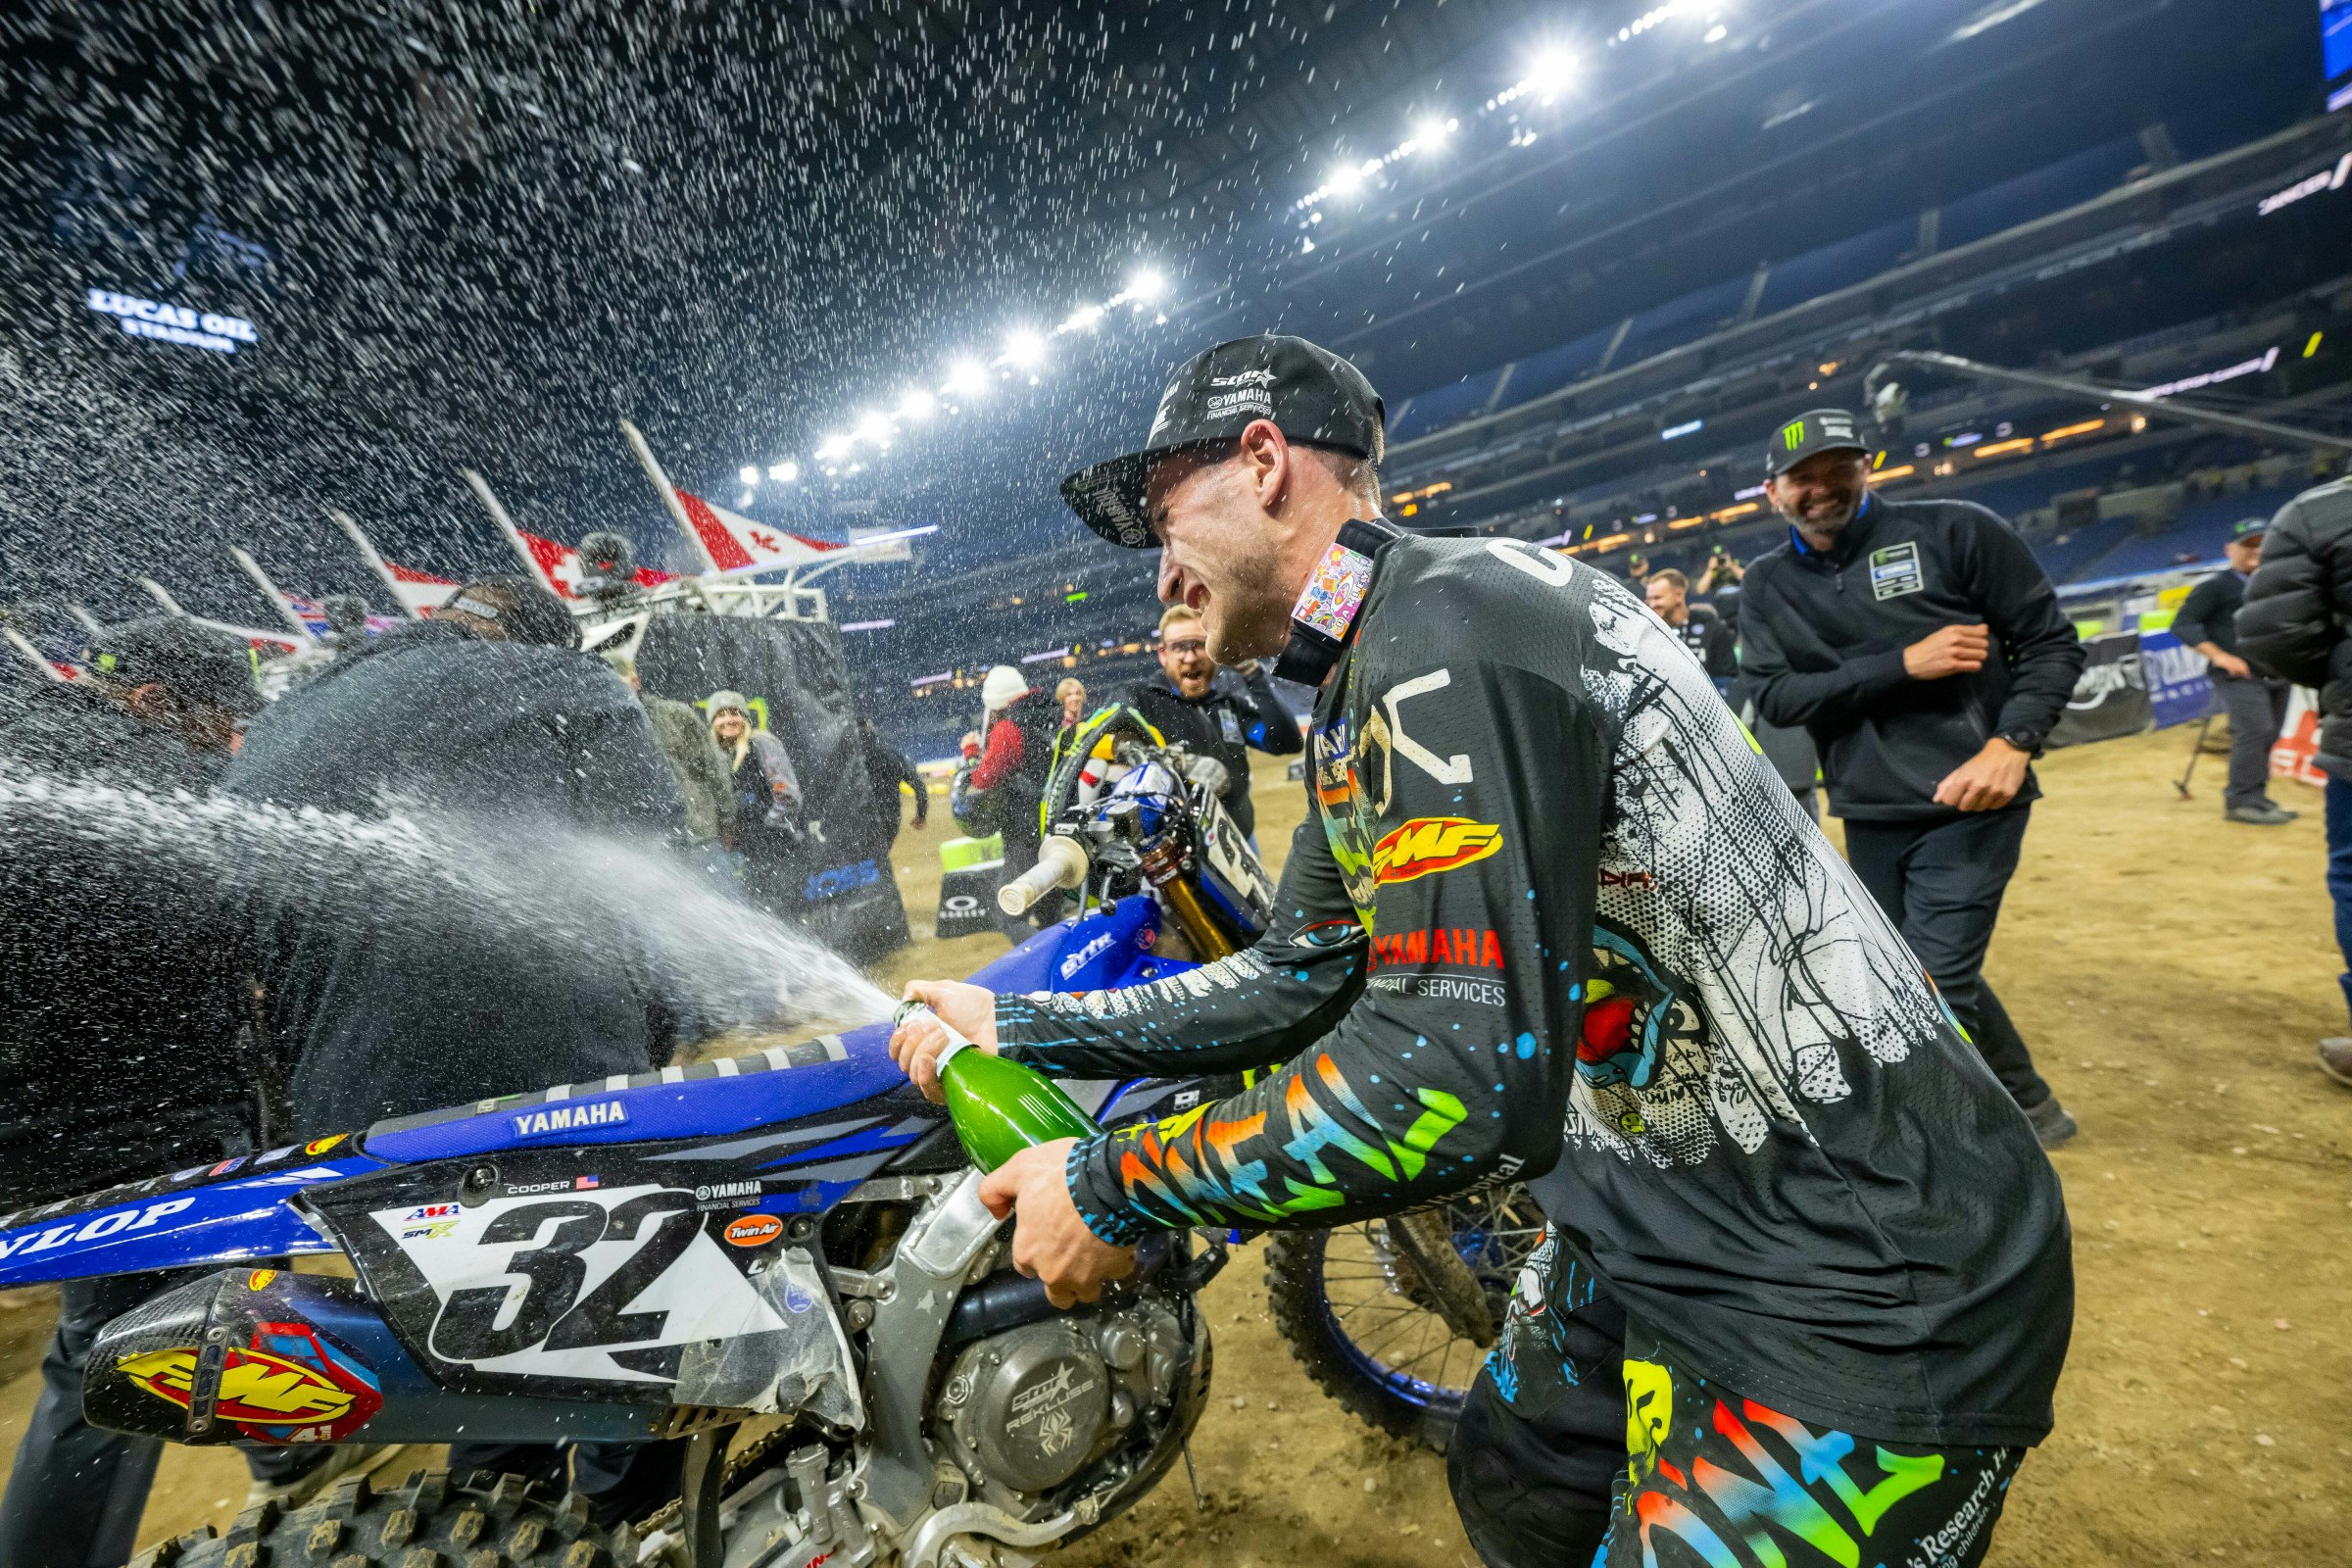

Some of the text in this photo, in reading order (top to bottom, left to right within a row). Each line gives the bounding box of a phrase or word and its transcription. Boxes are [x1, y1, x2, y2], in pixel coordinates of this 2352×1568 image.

[1223, 388, 1271, 406] YAMAHA
[1207, 406, 1239, 420] FINANCIAL
[1336, 570, 1369, 627] OAKLEY
[1060, 931, 1115, 980] GYTR
[1373, 927, 1505, 970] YAMAHA
[1417, 978, 1506, 1008] SERVICES
[515, 1102, 625, 1135] YAMAHA
[508, 1181, 570, 1195] COOPER
[710, 1180, 761, 1199] YAMAHA
[404, 1204, 461, 1222] AMA
[697, 1198, 761, 1212] FINANCIAL SERVICES
[402, 1220, 461, 1240] SMX
[730, 1222, 779, 1239] Twin Air
[432, 1190, 691, 1360] 32
[1005, 1379, 1095, 1433] REKLUSE
[1919, 1469, 1996, 1566] Research
